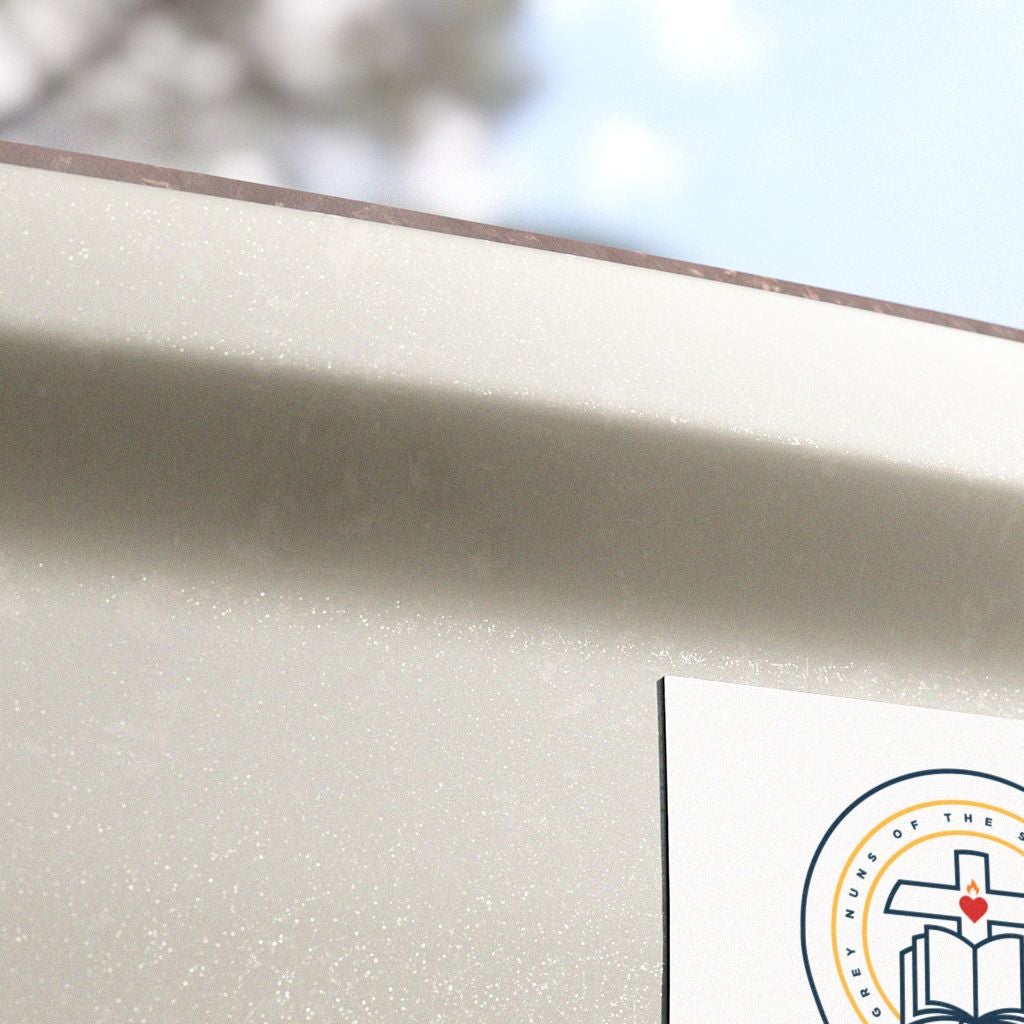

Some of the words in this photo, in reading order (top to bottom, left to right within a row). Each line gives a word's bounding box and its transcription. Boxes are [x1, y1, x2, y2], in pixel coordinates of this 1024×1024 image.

[892, 819, 919, 839] OF
[943, 812, 993, 827] THE
[844, 852, 878, 920] NUNS
[845, 947, 882, 1018] GREY
